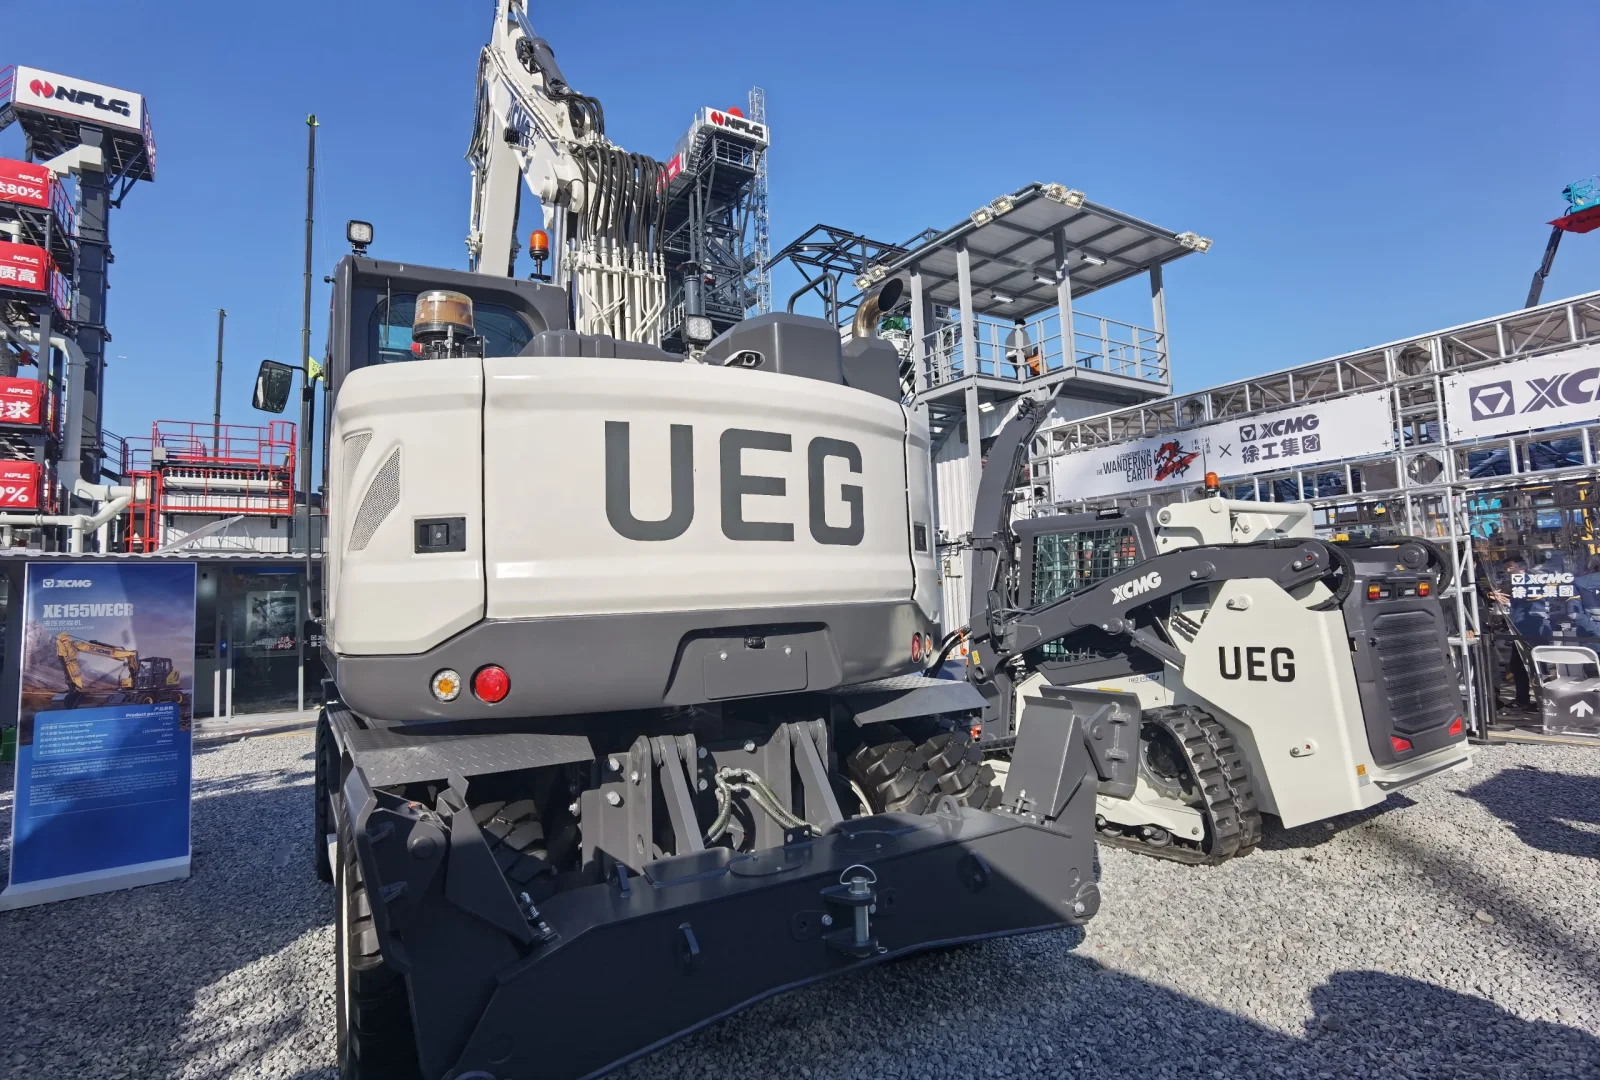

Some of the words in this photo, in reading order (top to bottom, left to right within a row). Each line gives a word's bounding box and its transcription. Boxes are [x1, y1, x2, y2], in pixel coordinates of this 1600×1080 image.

[55, 86, 130, 118] NFLG
[725, 115, 764, 139] NFLG
[1520, 366, 1600, 414] XC
[0, 399, 31, 419] 求
[1259, 413, 1320, 441] XCMG
[1241, 433, 1322, 464] 徐工集团
[1103, 453, 1152, 475] WANDERING
[604, 420, 865, 546] UEG
[54, 579, 92, 588] XCMG
[1111, 571, 1162, 605] XCMG
[1511, 585, 1574, 599] 徐工集团
[1526, 572, 1575, 585] XCMG
[1218, 646, 1296, 683] UEG
